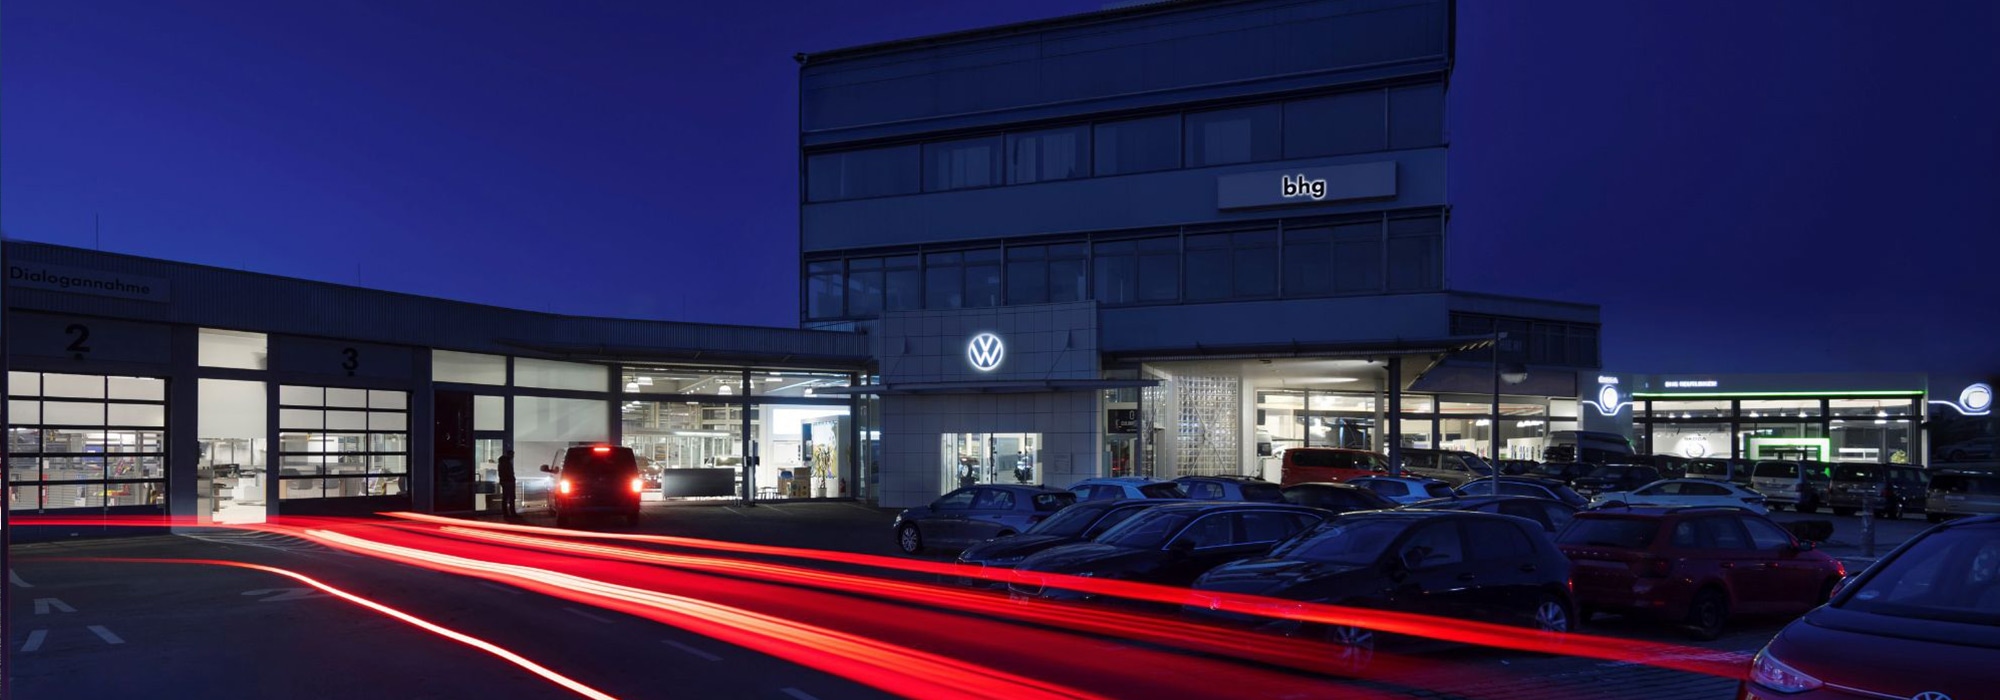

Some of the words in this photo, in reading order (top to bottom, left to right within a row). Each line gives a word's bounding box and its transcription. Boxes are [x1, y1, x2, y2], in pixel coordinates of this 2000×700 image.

[1283, 175, 1325, 199] bhg
[10, 265, 151, 295] Dialogannahme
[65, 323, 91, 352] 2
[342, 348, 359, 370] 3
